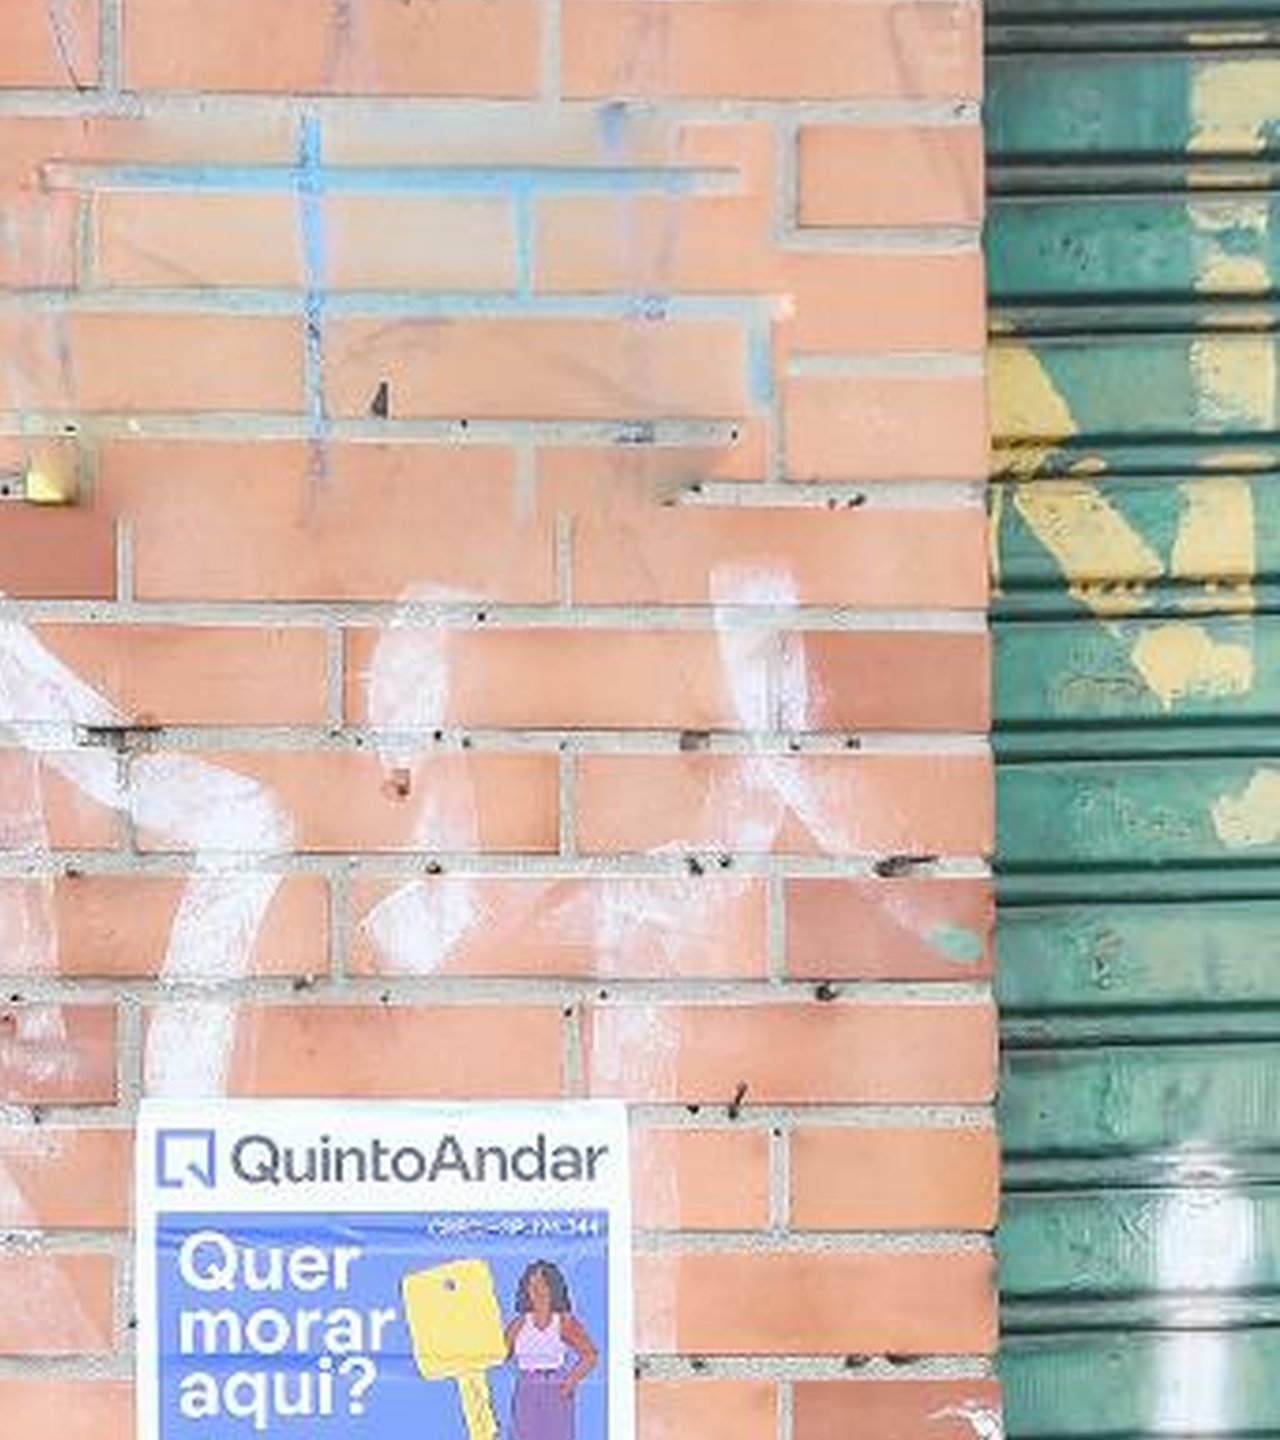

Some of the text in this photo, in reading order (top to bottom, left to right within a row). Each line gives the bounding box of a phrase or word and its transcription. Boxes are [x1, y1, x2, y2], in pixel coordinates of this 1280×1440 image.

[231, 1133, 609, 1186] QuintoAndar
[179, 1229, 362, 1292] Quer
[180, 1307, 397, 1355] morar
[179, 1356, 378, 1430] aqui?
